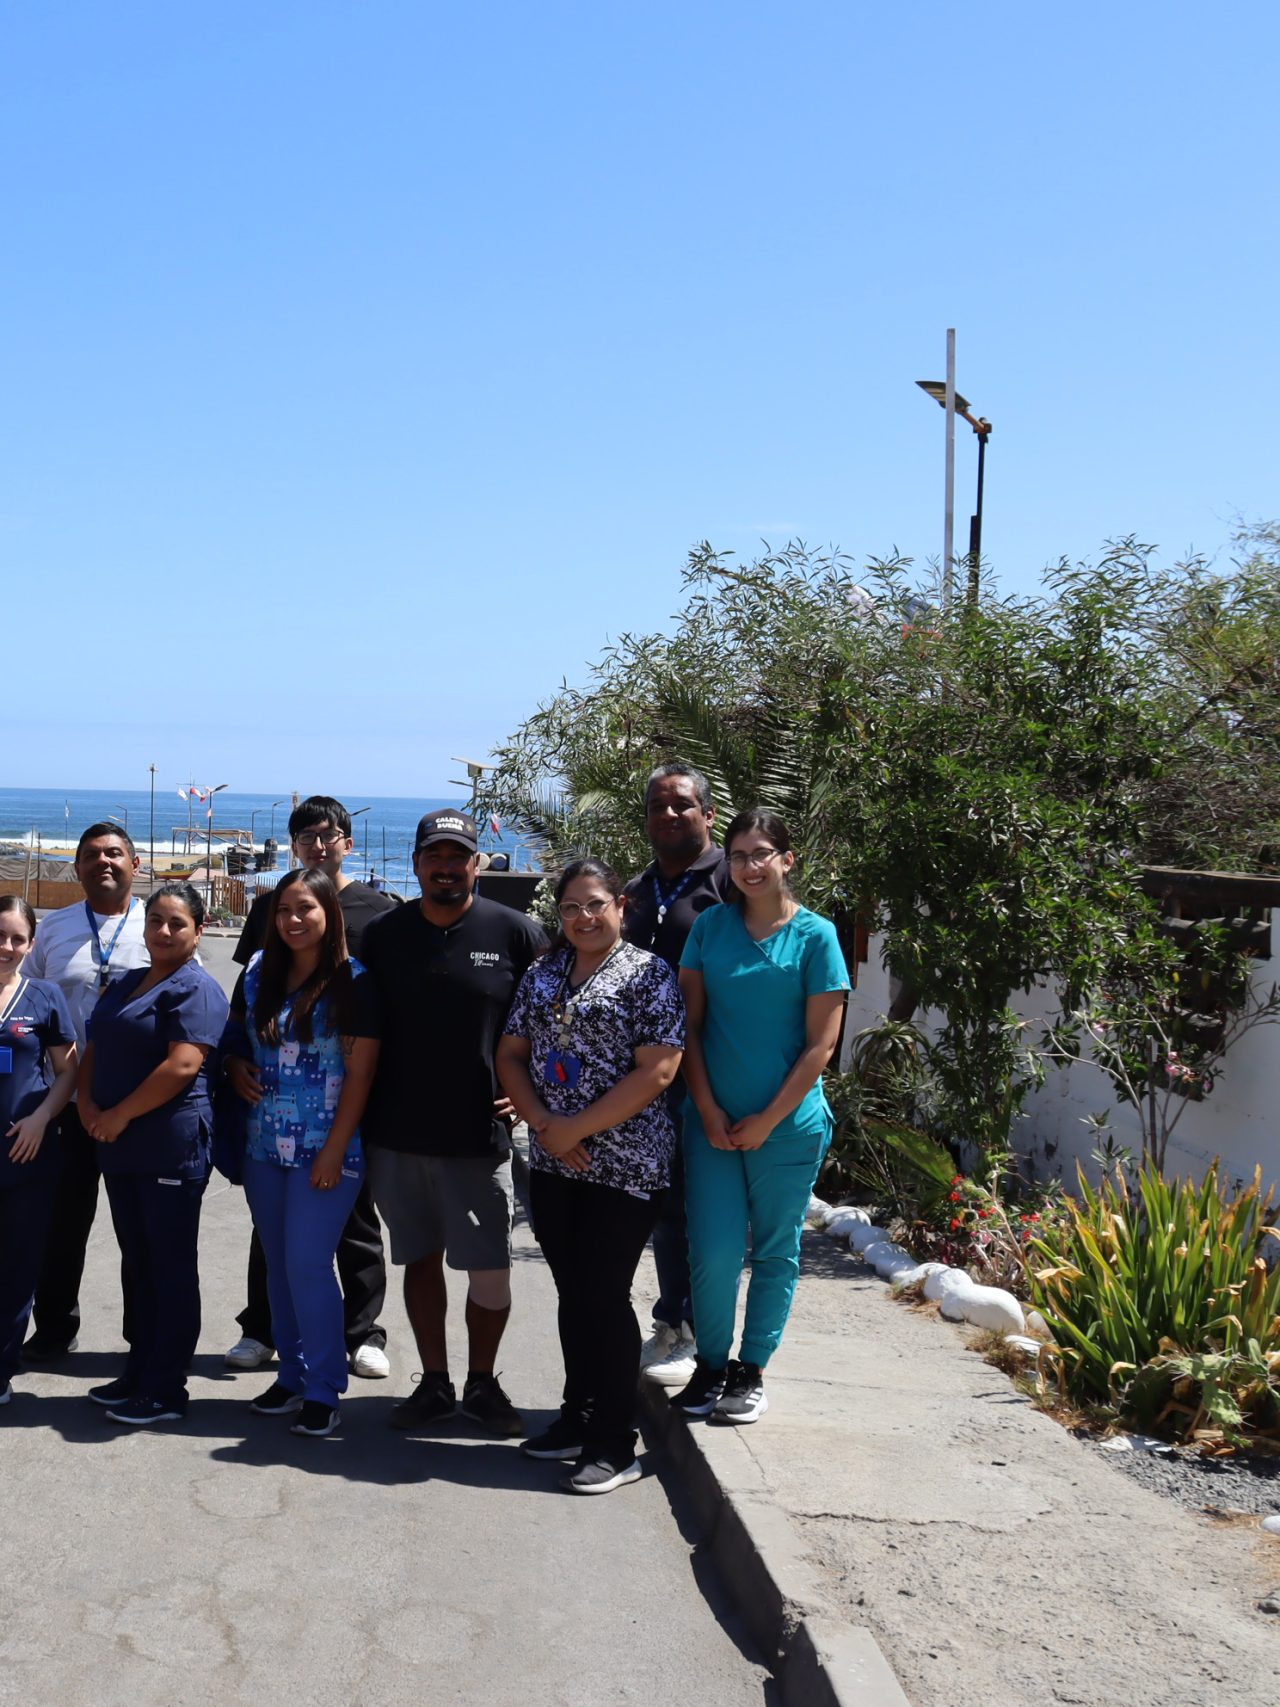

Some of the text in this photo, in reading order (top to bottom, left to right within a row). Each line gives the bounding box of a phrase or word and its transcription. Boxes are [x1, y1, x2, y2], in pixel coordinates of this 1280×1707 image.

[435, 816, 464, 826] CALETA
[437, 823, 463, 831] BUENA
[470, 951, 500, 961] CHICAGO
